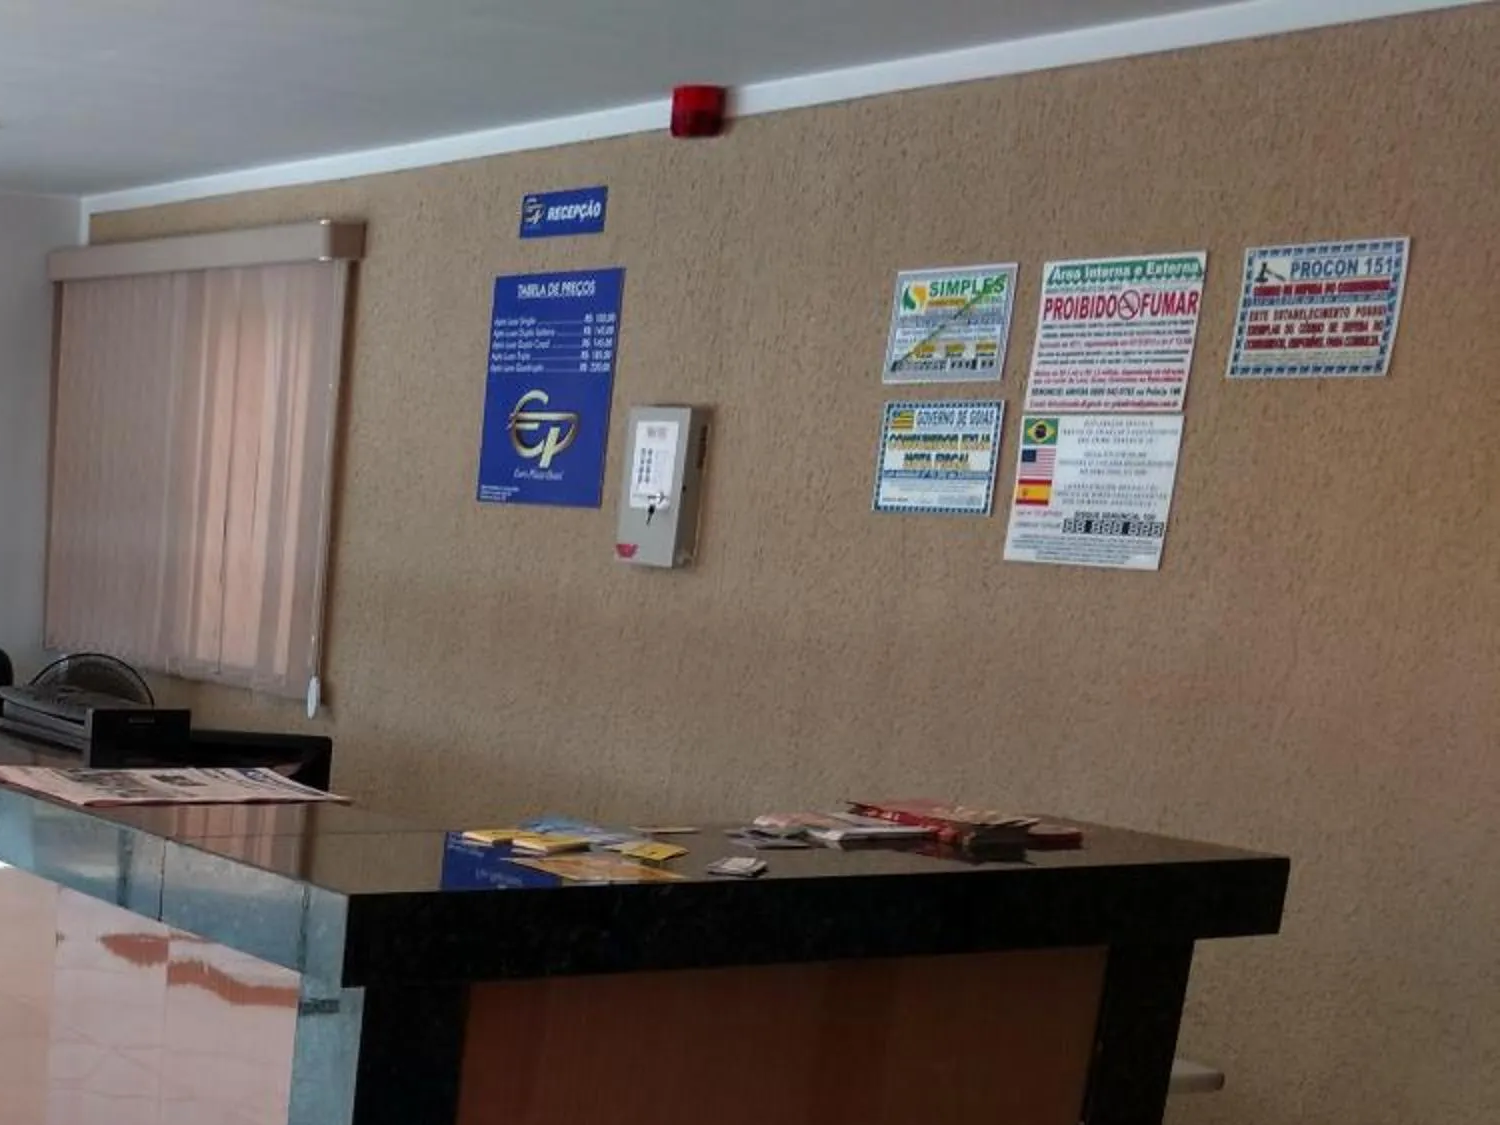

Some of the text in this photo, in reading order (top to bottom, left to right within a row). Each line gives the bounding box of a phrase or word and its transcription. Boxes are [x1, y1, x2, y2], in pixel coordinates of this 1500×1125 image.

[547, 200, 601, 222] RECEPÇÃO
[1290, 257, 1393, 278] PROCON 151
[518, 283, 546, 299] TABELA
[548, 282, 560, 296] DE
[929, 278, 1006, 297] SIMPLES
[1044, 289, 1199, 320] PROIBIDO FUMAR
